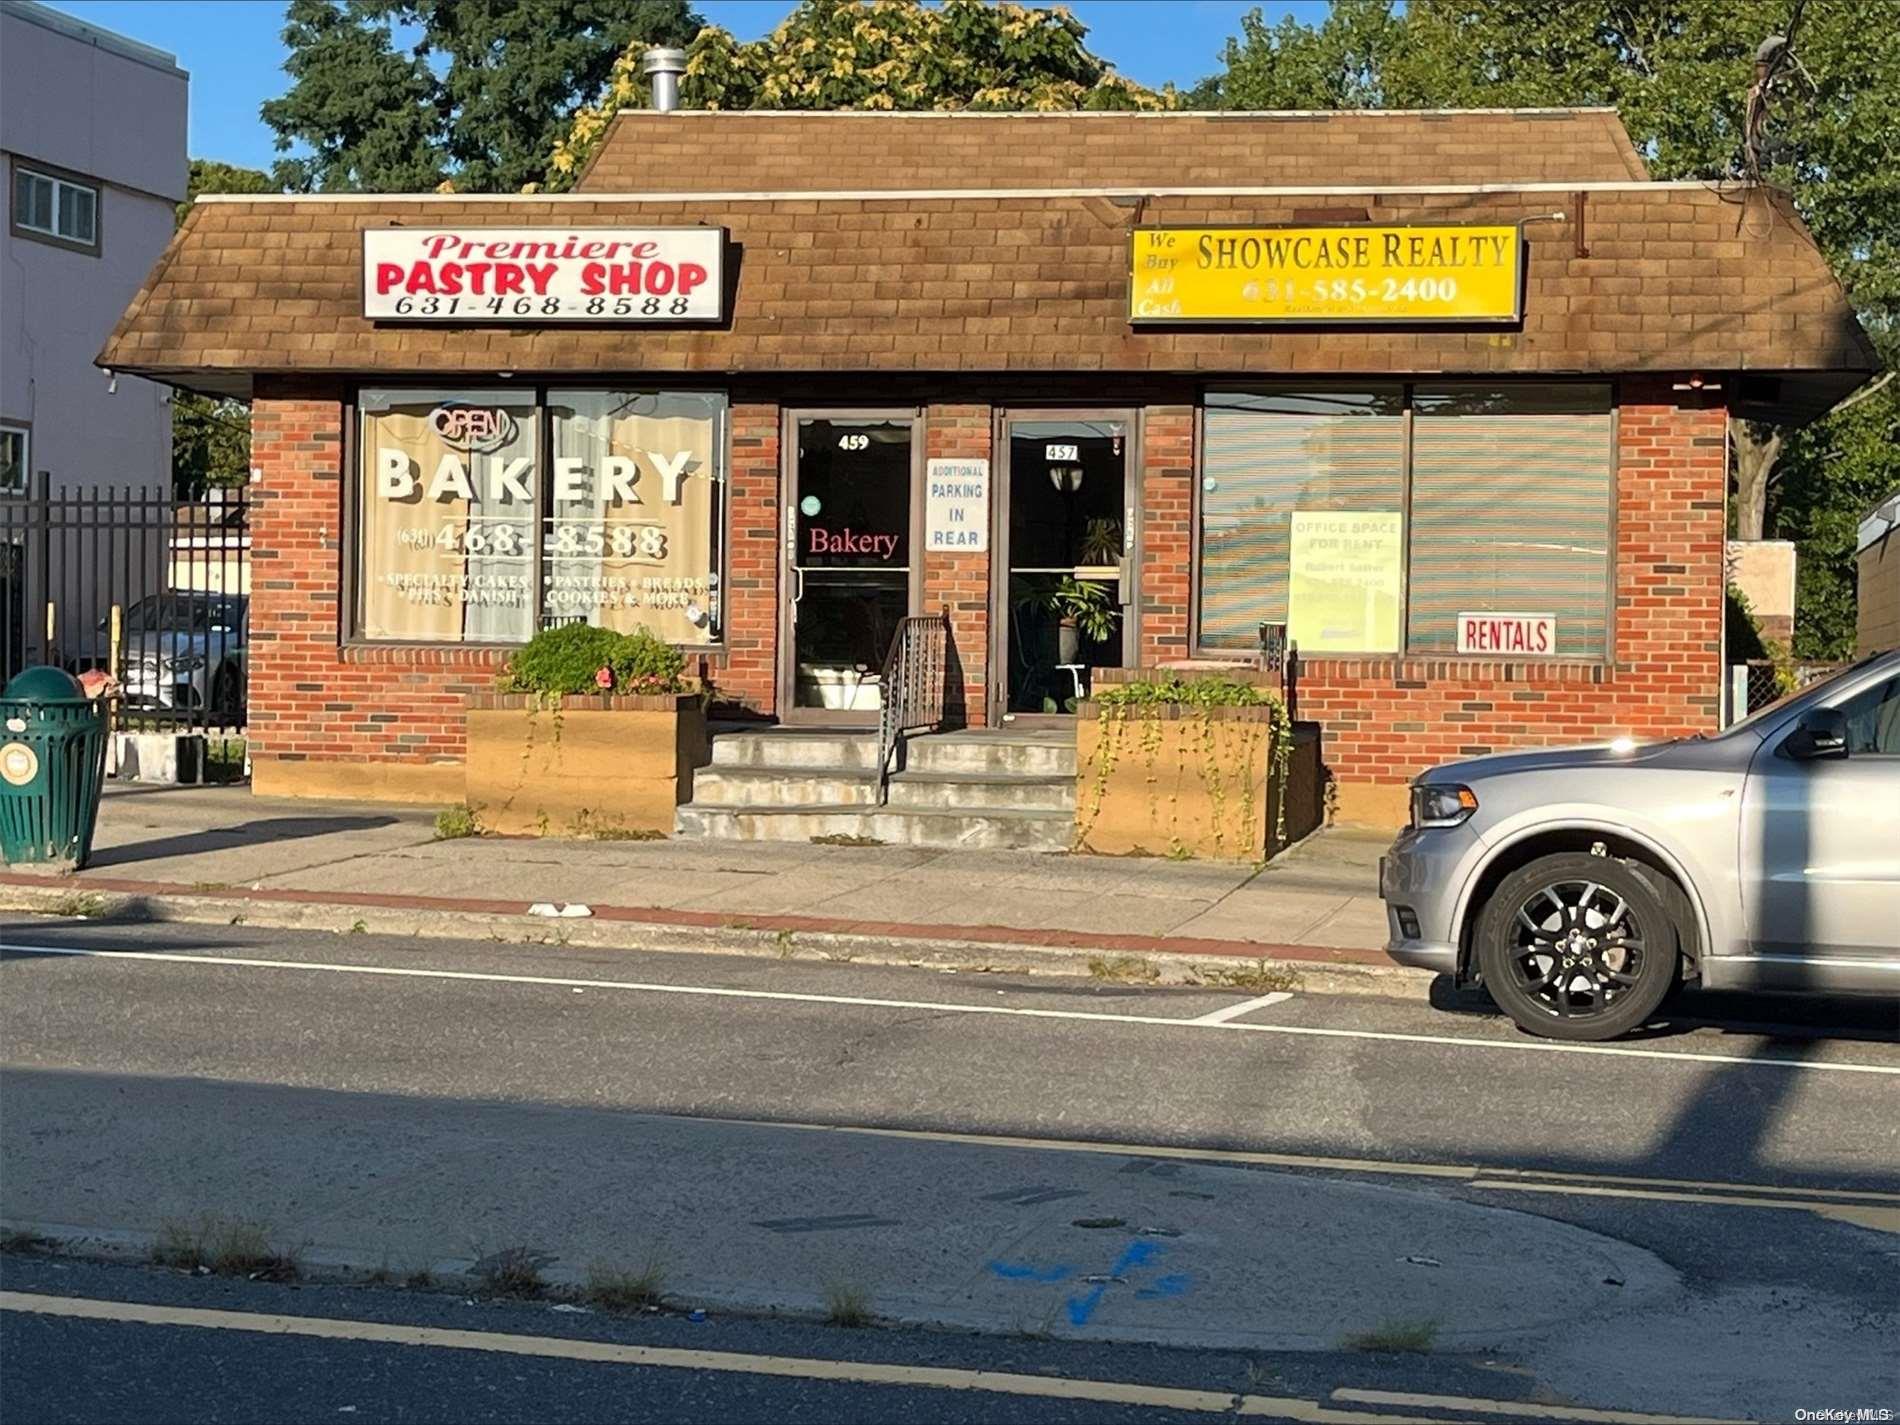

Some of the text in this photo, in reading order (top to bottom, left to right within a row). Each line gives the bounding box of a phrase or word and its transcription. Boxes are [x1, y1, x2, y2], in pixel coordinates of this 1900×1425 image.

[422, 234, 660, 260] Premiere
[1149, 232, 1176, 248] We
[1196, 233, 1510, 269] SHOWCASE REALTY
[1145, 253, 1179, 271] Buy
[376, 261, 707, 296] PASTRY SHOP
[1242, 278, 1457, 303] 631-585-2400
[395, 297, 690, 316] 631-468-8588
[431, 409, 502, 436] OPEN
[838, 434, 869, 450] 459
[1048, 446, 1077, 460] 457
[379, 447, 694, 502] BAKERY
[932, 466, 983, 477] ADDITIONAL
[932, 484, 983, 498] PARKING
[949, 508, 965, 522] IN
[1296, 522, 1397, 533] OFFICE SPACE
[809, 527, 899, 560] Bakery
[934, 531, 978, 545] REAR
[1309, 538, 1384, 550] FOR RENT
[386, 573, 703, 588] SPECIALTY CAKES PASTRIES BREADS
[459, 589, 516, 602] DANISH
[546, 590, 618, 604] COOKIES
[624, 592, 635, 604] &
[642, 591, 689, 605] MORE
[1465, 618, 1548, 652] RENTALS
